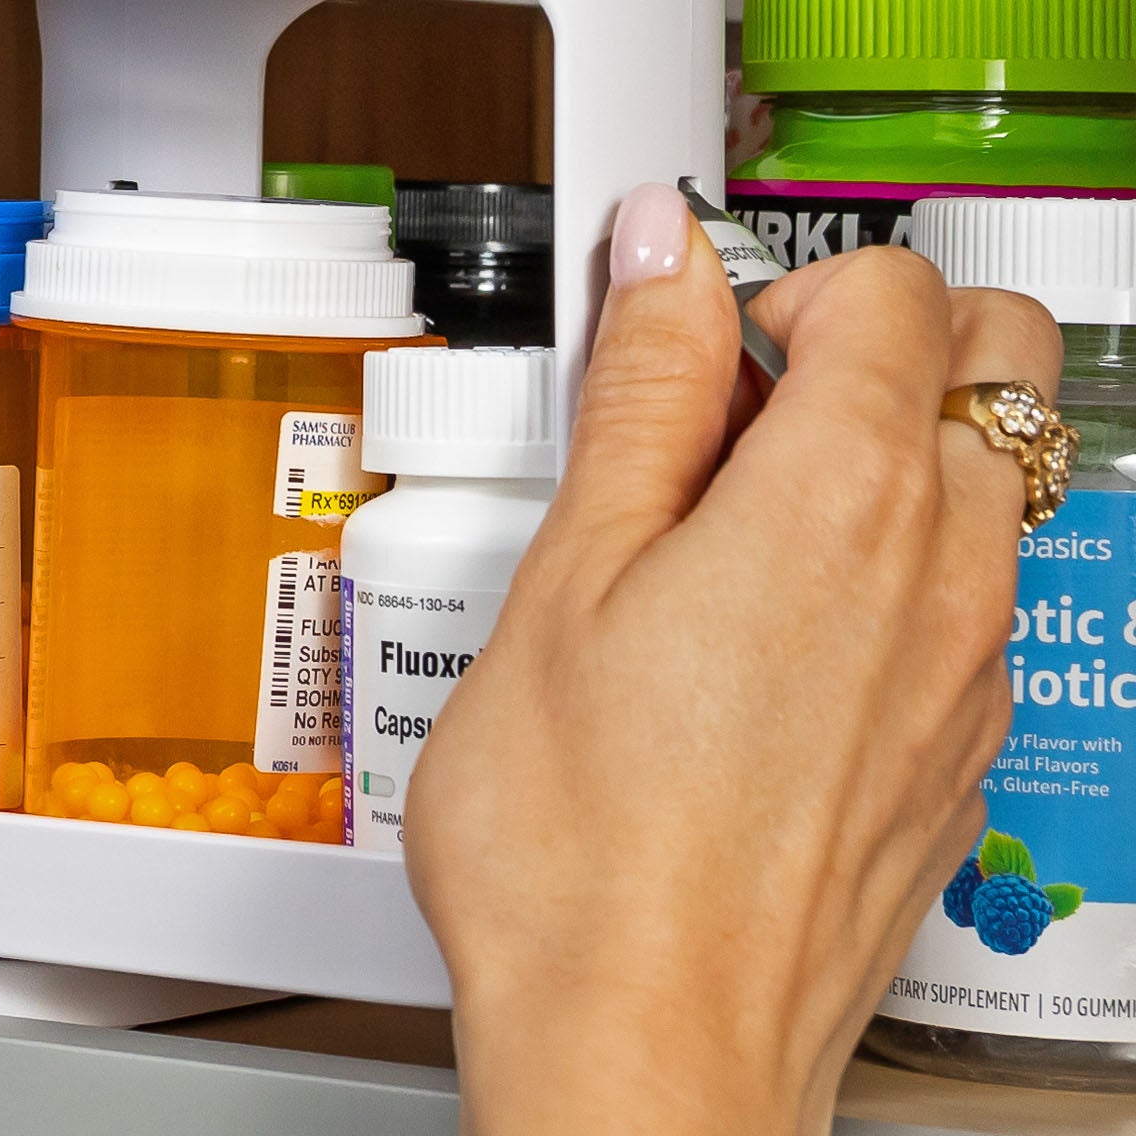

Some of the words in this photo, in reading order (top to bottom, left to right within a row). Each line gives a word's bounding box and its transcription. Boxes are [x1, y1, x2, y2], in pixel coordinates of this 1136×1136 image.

[293, 421, 328, 433] SAM'S
[331, 423, 356, 435] CLUB
[292, 434, 354, 447] PHARMACY
[304, 575, 326, 592] AT
[331, 576, 340, 592] B
[357, 591, 373, 606] NDC
[378, 595, 464, 612] 68645-130-54
[345, 601, 353, 629] mg
[1009, 595, 1105, 645] otic
[302, 620, 341, 636] FLUO
[343, 634, 352, 658] 20
[381, 640, 484, 678] Fluoxe
[298, 669, 331, 685] QTY
[336, 669, 342, 684] 9
[1012, 655, 1136, 708] iotic
[296, 690, 342, 707] BOHM
[345, 679, 353, 704] mg
[294, 712, 316, 729] No
[322, 712, 340, 728] Re
[343, 710, 351, 734] 20
[292, 736, 305, 745] DO
[309, 736, 327, 745] NOT
[329, 736, 341, 745] FLU
[1023, 734, 1077, 751] Flavor
[1083, 737, 1122, 753] with
[345, 754, 353, 780] mg
[1035, 757, 1099, 774] Flavors
[1003, 777, 1110, 797] Gluten-Free
[344, 786, 351, 809] 20
[372, 810, 402, 826] PHARM
[931, 984, 1030, 1013] SUPPLEMENT
[1052, 996, 1072, 1016] 50
[1077, 998, 1136, 1018] GUMMI
